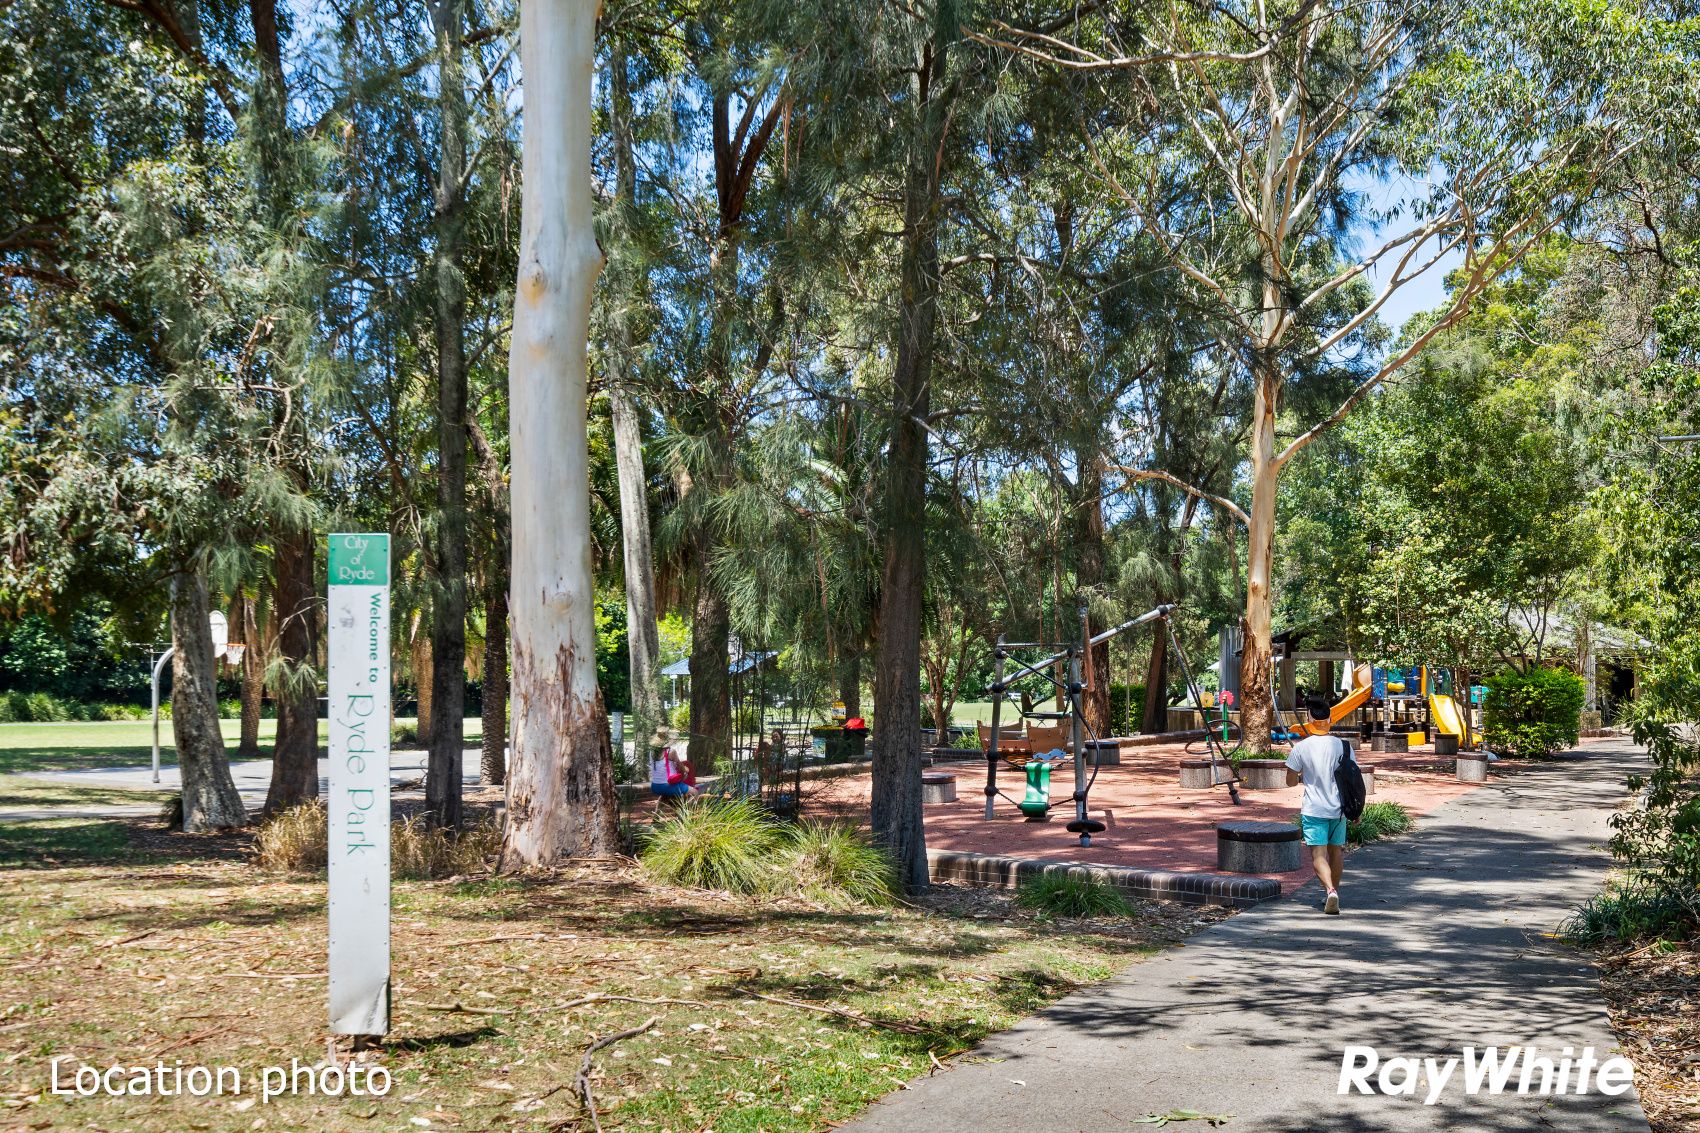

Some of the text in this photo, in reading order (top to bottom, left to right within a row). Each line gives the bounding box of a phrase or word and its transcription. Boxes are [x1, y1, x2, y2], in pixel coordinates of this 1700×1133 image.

[344, 535, 369, 555] City
[340, 565, 376, 584] Ryde
[369, 593, 381, 683] Welcome to
[337, 695, 375, 855] Ryde Park
